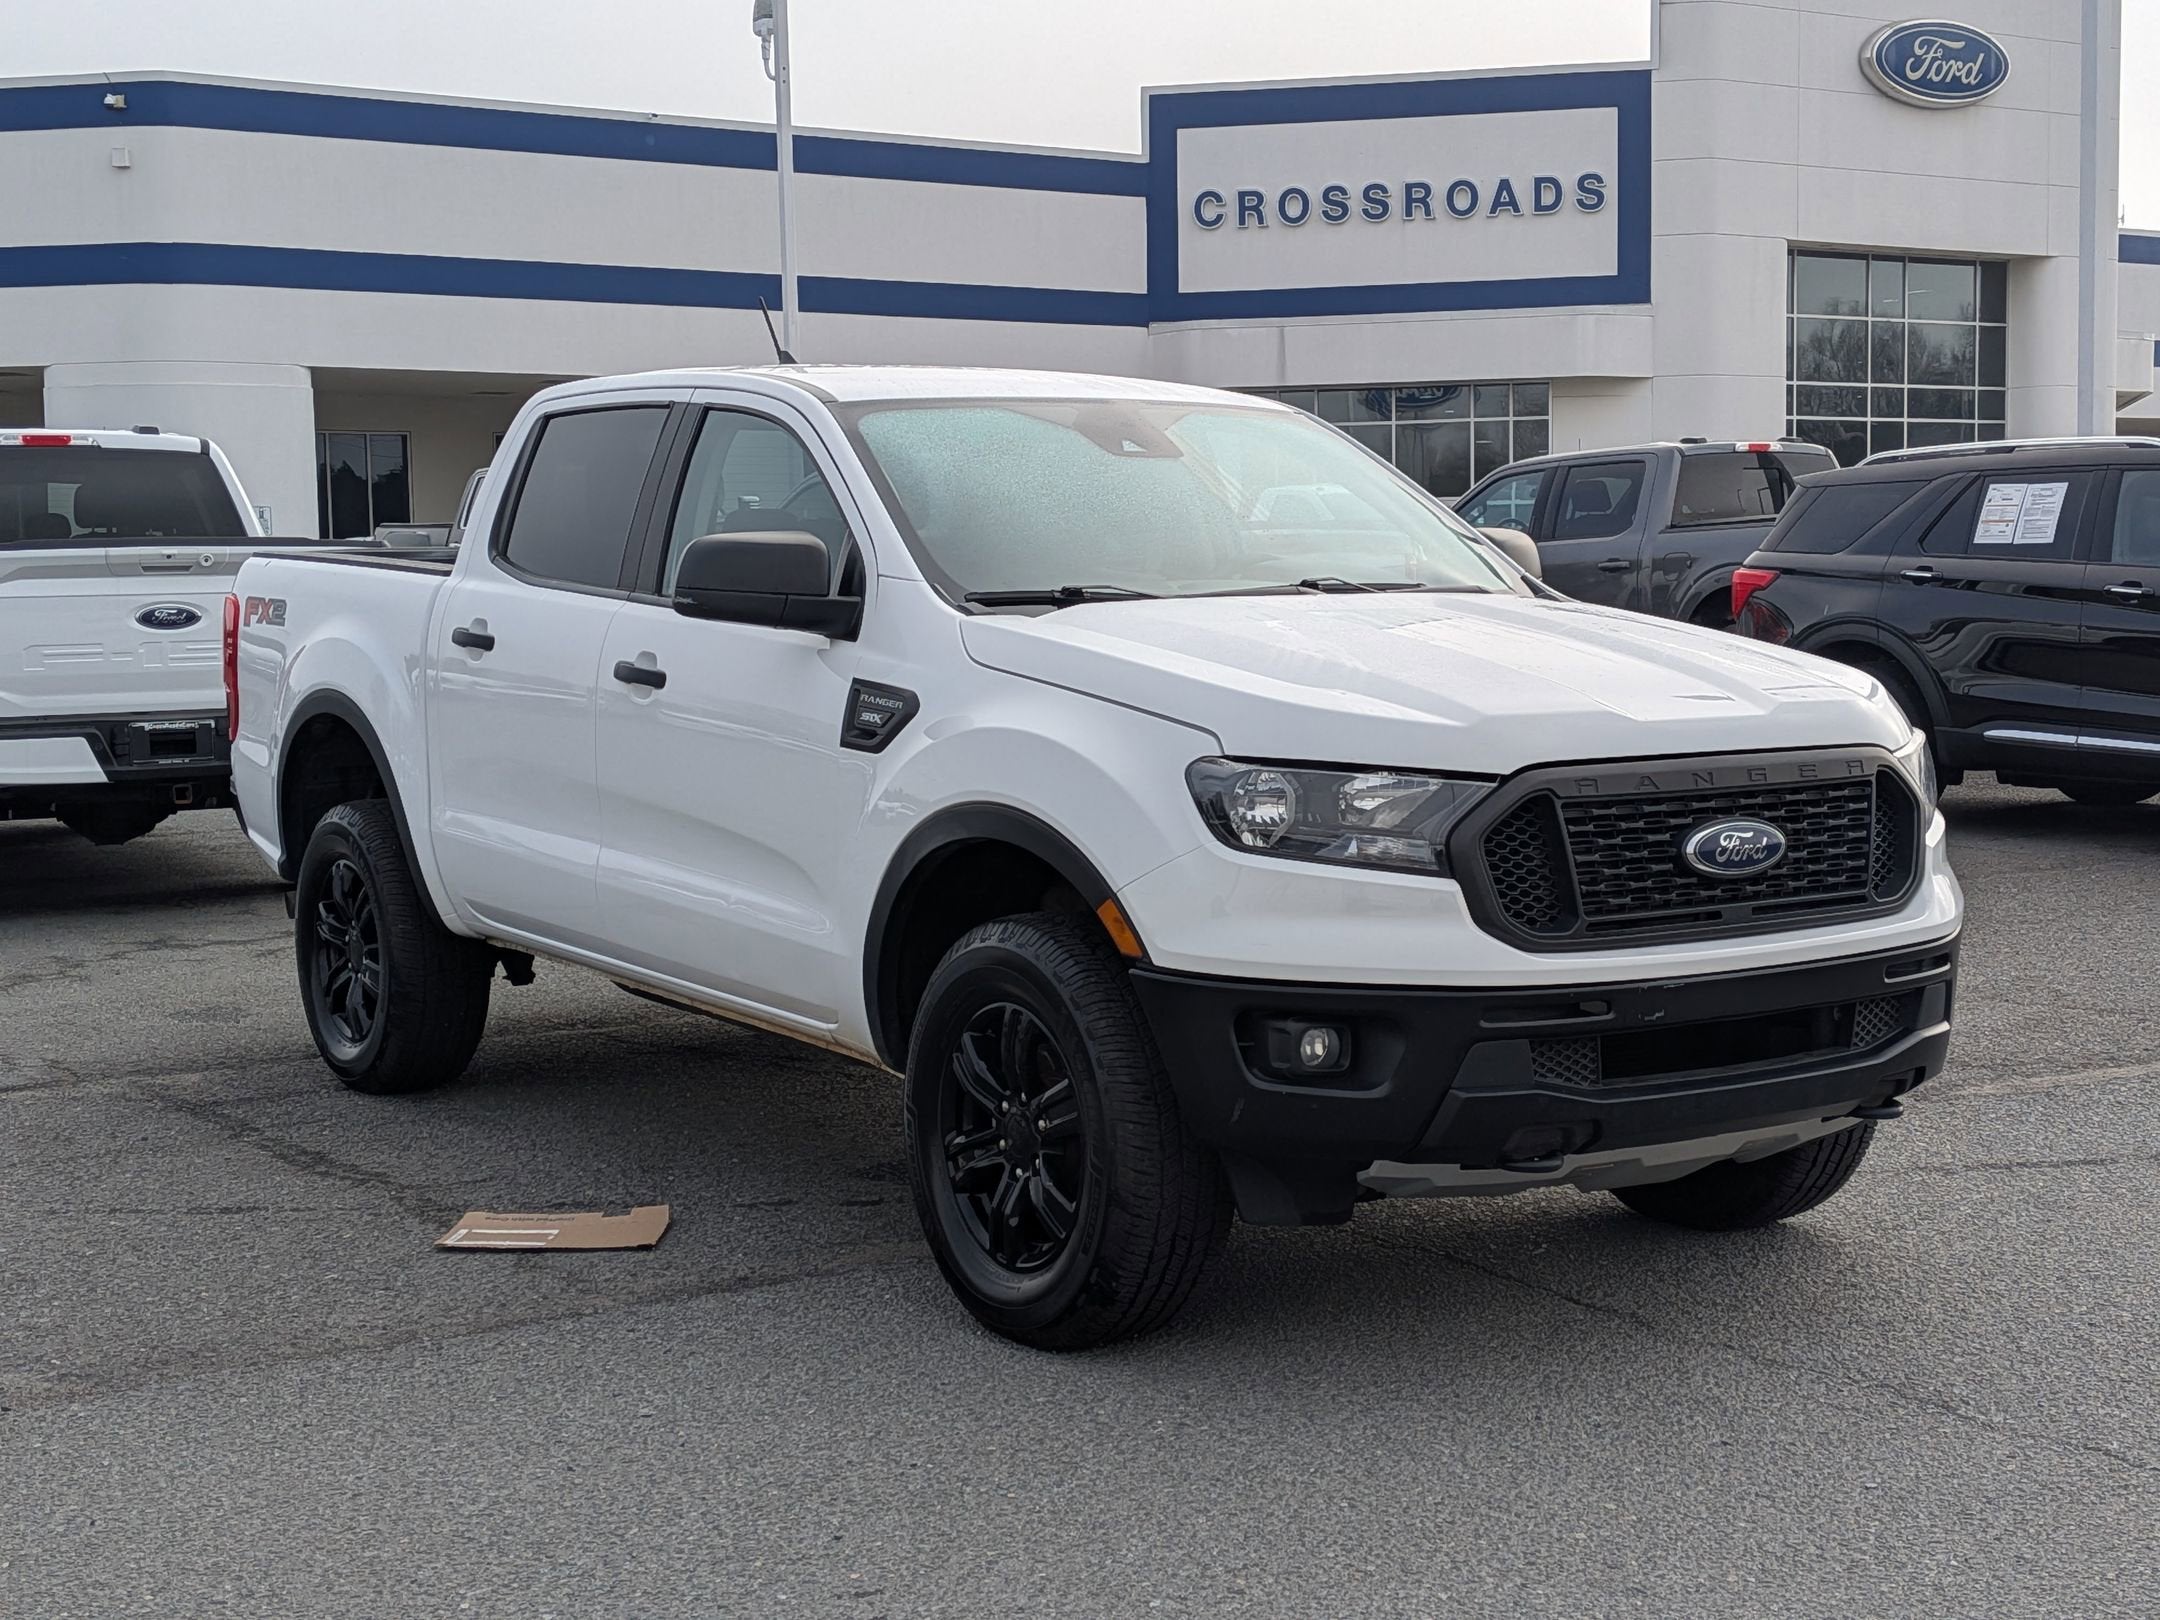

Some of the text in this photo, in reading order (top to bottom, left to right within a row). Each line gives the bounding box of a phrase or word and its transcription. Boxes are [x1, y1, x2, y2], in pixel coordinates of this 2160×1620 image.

[1905, 36, 1985, 85] Ford
[1193, 170, 1608, 230] CROSSROADS
[151, 609, 187, 624] Ford
[243, 595, 287, 627] FX2
[23, 640, 224, 670] F-15
[860, 694, 904, 709] RANGER
[859, 712, 883, 724] STX
[1574, 759, 1865, 795] RANGER
[1715, 831, 1768, 863] Ford
